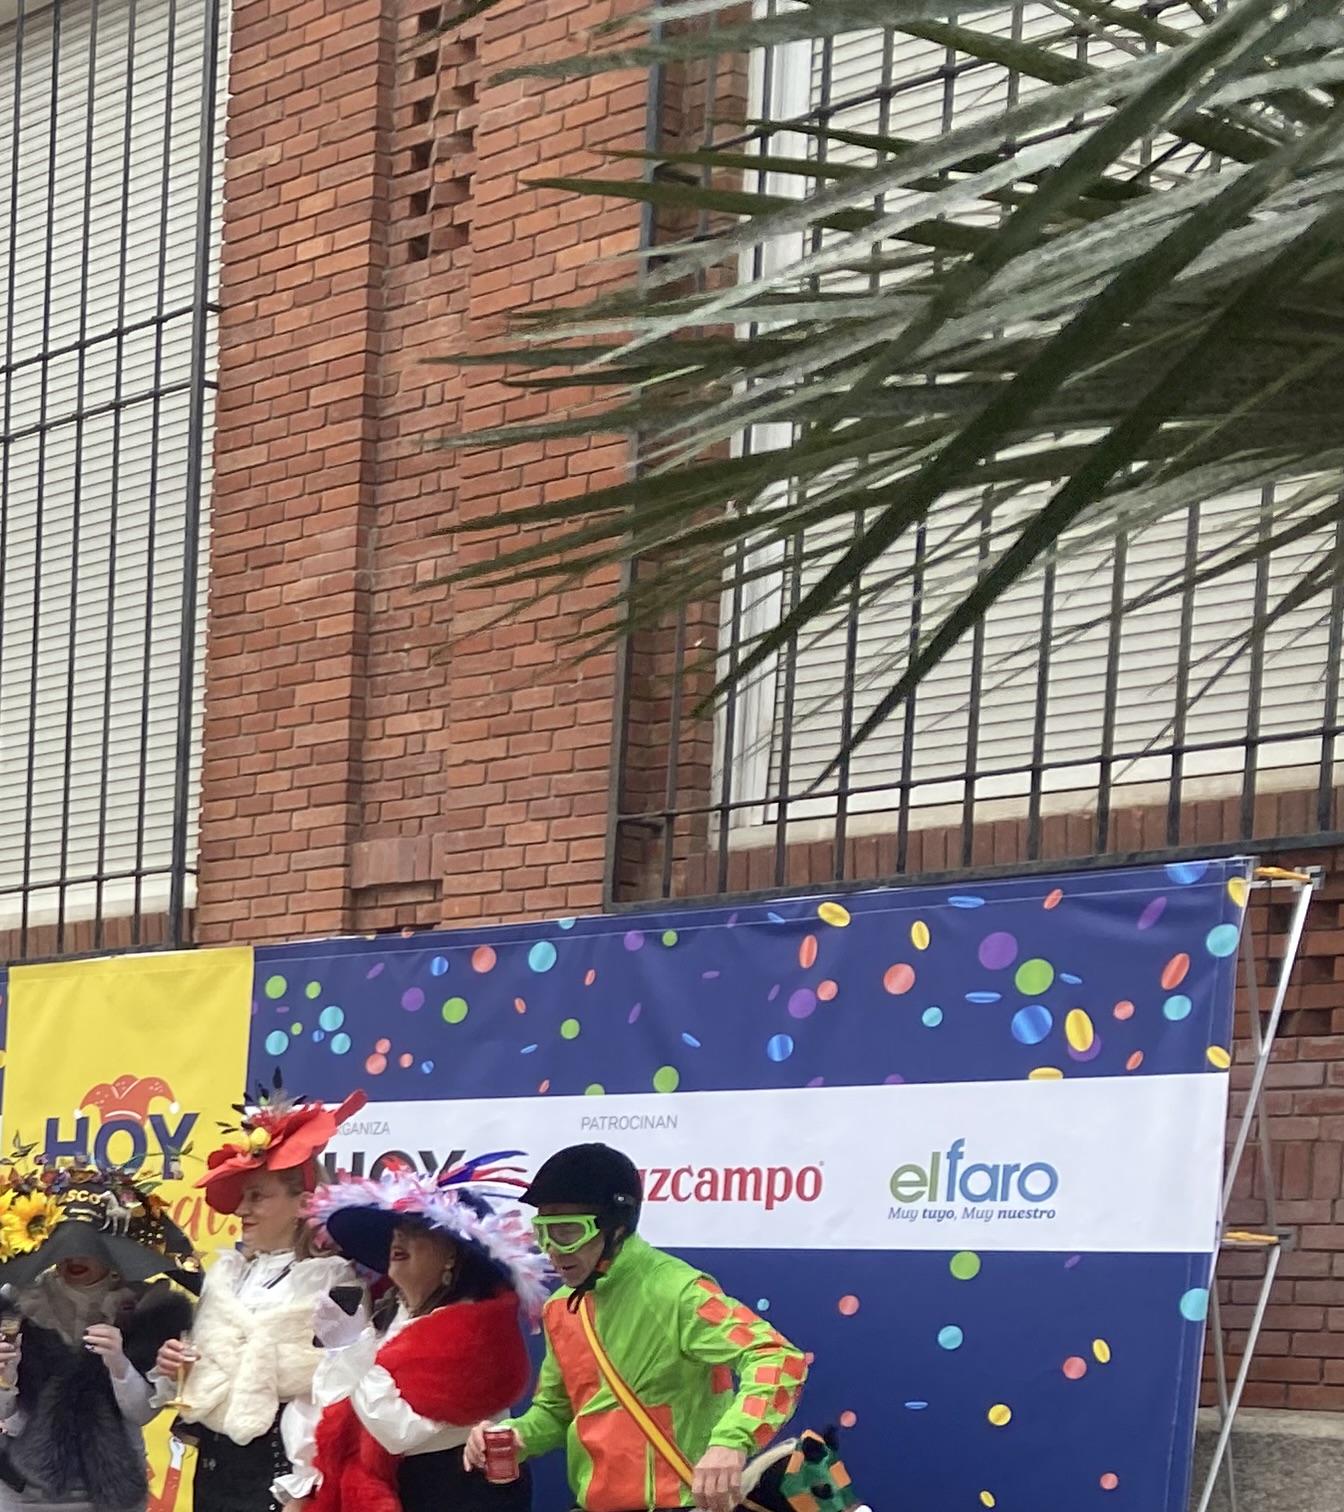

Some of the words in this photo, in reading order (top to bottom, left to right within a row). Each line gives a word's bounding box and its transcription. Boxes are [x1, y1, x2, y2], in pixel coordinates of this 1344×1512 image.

[335, 1121, 391, 1136] GANIZA
[580, 1115, 679, 1131] PATROCINAN
[44, 1111, 200, 1181] HOY
[888, 1206, 920, 1223] Muy
[921, 1208, 958, 1223] tuyo,
[961, 1206, 995, 1223] Muy
[997, 1207, 1056, 1220] nuestro
